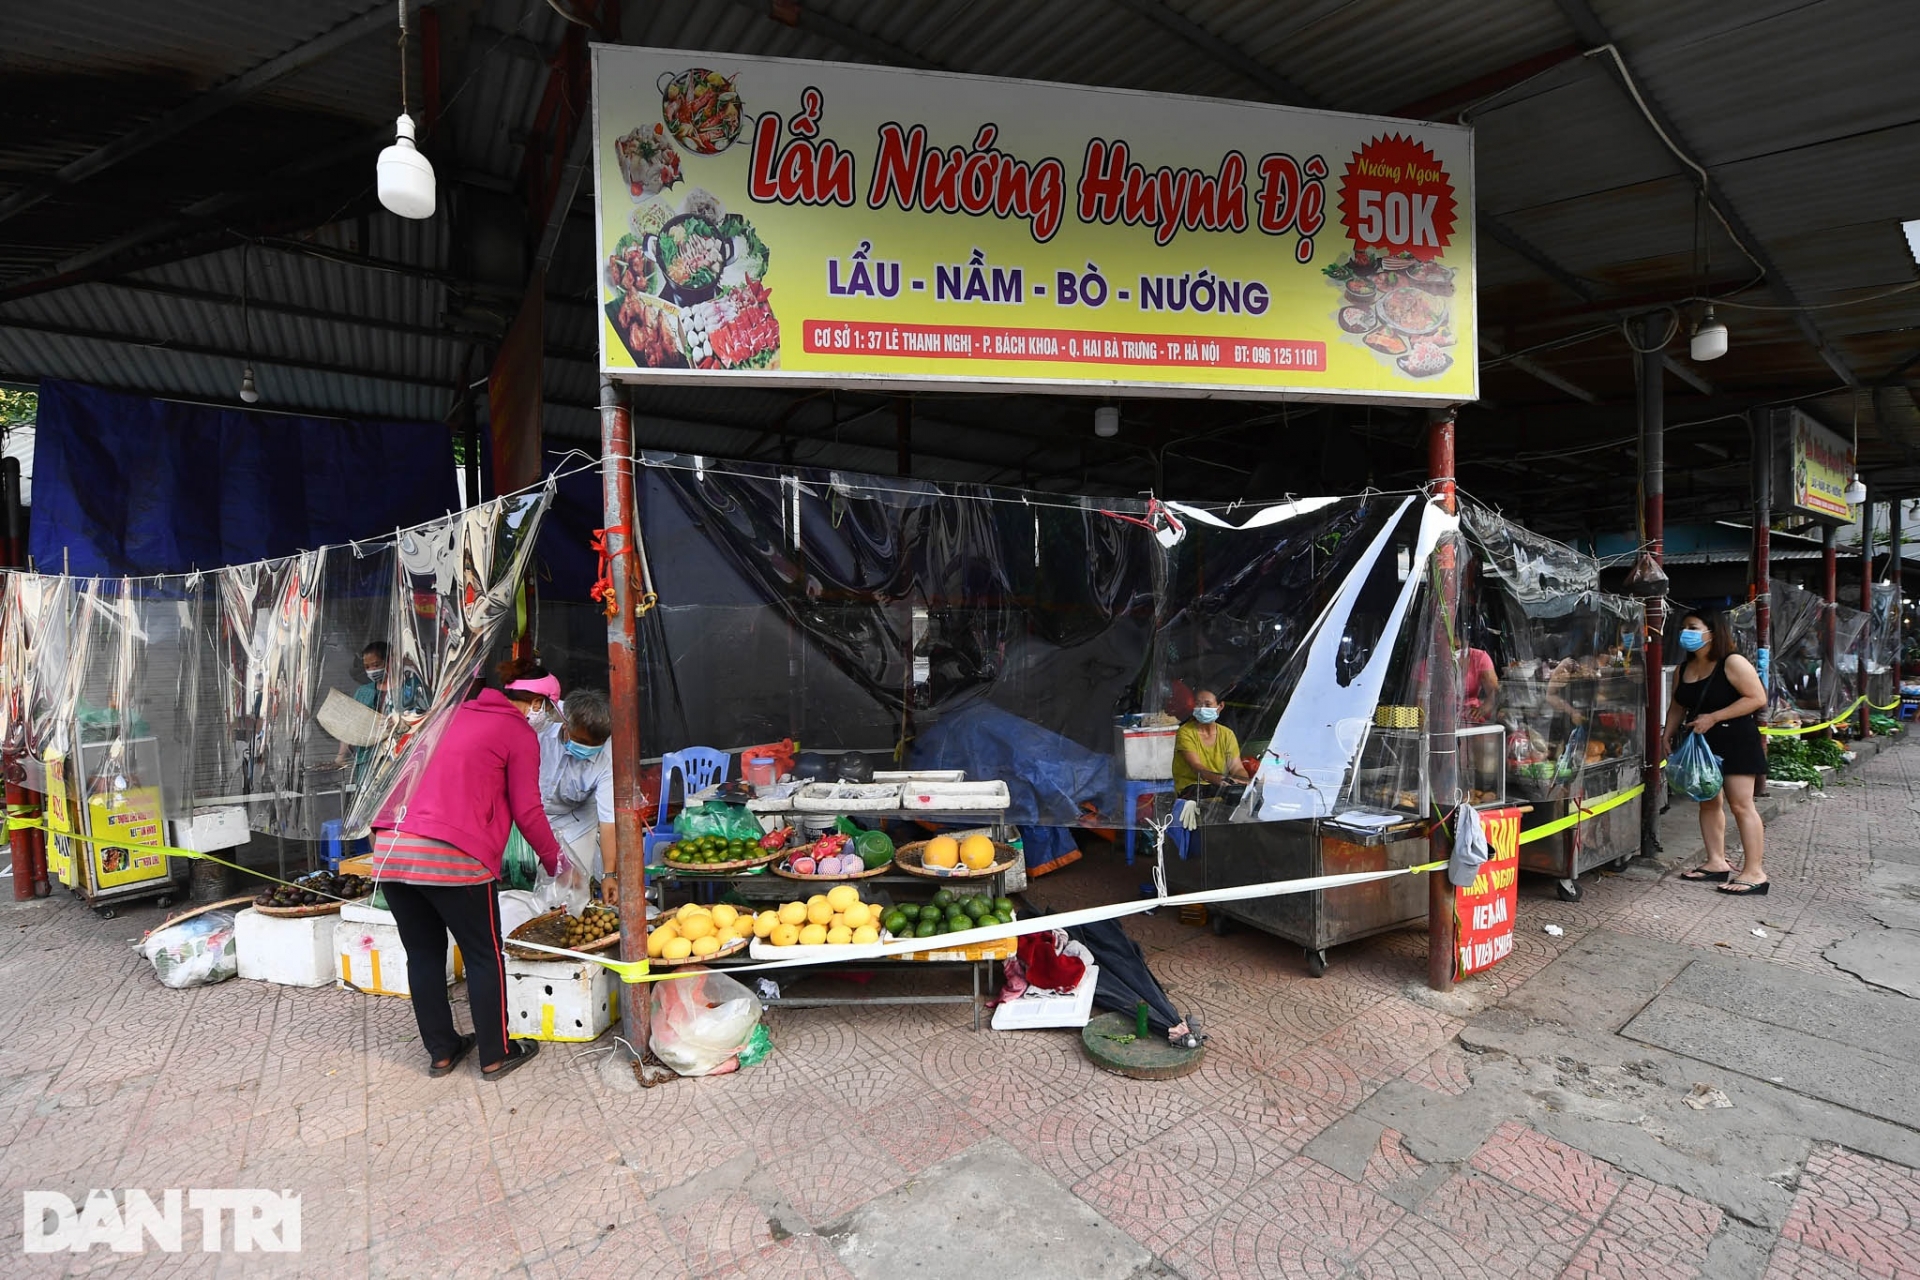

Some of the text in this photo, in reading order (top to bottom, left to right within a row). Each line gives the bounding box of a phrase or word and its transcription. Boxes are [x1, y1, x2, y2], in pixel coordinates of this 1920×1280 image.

[868, 123, 1065, 243] Nướng
[1078, 138, 1248, 246] Huynh
[1255, 153, 1328, 263] Đệ
[1356, 158, 1440, 187] Nướng Ngon
[1357, 189, 1440, 248] 50K
[828, 241, 900, 298] LẨU
[936, 248, 1023, 303] NẦM
[1057, 262, 1108, 307] BÒ
[1140, 269, 1270, 315] NƯỚNG
[814, 327, 832, 348] CƠ
[834, 324, 851, 349] SỞ
[854, 330, 865, 349] 1:
[867, 331, 883, 350] 37
[885, 328, 899, 350] LÊ
[902, 332, 941, 352] THANH
[944, 333, 972, 357] NGHỊ
[983, 336, 992, 353] P.
[995, 332, 1025, 354] BÁCH
[1029, 337, 1059, 355] KHOA
[1069, 339, 1080, 358] Q.
[1083, 339, 1101, 358] HAI
[1104, 336, 1119, 359] BÀ
[1121, 340, 1157, 360] TRƯNG
[1167, 343, 1182, 361] TP.
[1184, 338, 1199, 361] HÀ
[1201, 341, 1220, 365] NỘI
[1234, 345, 1249, 364] ĐT:
[1252, 346, 1270, 364] 096
[1274, 347, 1292, 365] 125
[1294, 348, 1318, 366] 1101
